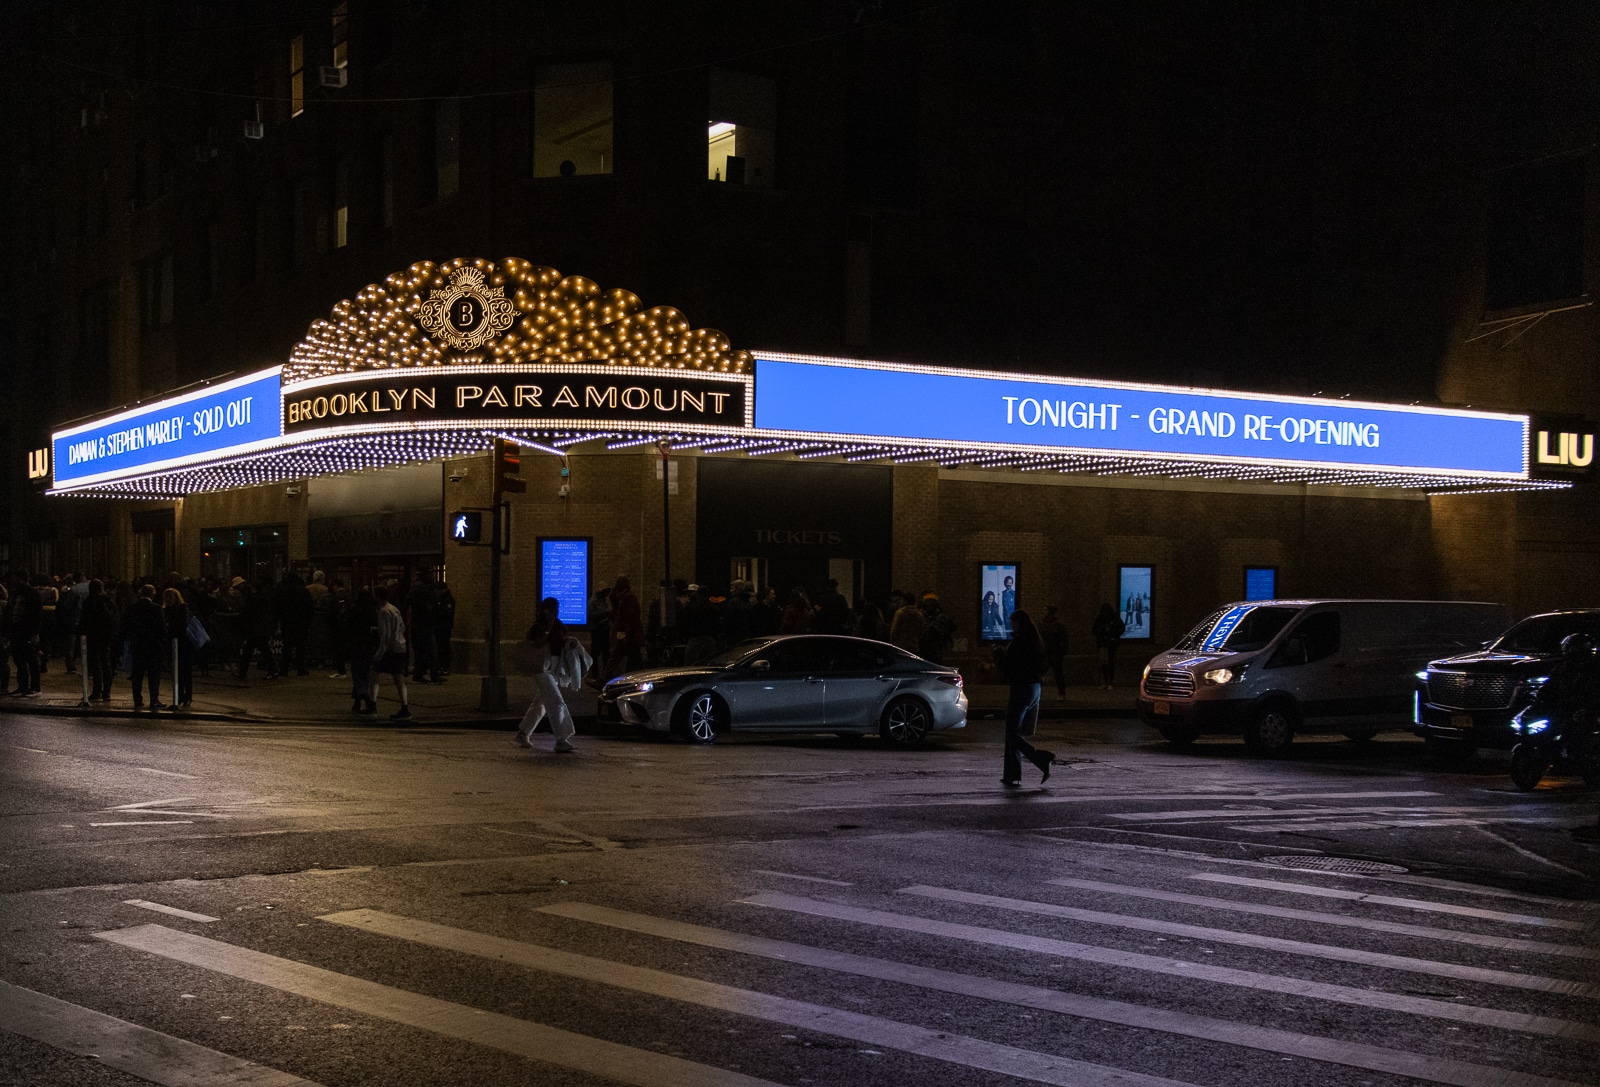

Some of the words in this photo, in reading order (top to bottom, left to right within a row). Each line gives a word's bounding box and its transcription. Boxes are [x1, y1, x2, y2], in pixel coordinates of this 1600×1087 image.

[459, 302, 474, 327] B
[288, 387, 437, 424] BROOKLYN
[456, 385, 731, 415] PARAMOUNT
[1002, 396, 1123, 431] TONIGHT
[1148, 407, 1236, 438] GRAND
[1244, 414, 1381, 448] RE-OPENING
[68, 439, 98, 466] DAMIAN
[98, 437, 106, 459] &
[107, 426, 145, 457] STEPHEN
[146, 415, 185, 448] MARLEY
[193, 405, 224, 437] SOLD
[226, 396, 254, 428] OUT
[1538, 430, 1594, 467] LIU
[28, 447, 49, 479] LIU
[754, 528, 842, 545] TICKETS
